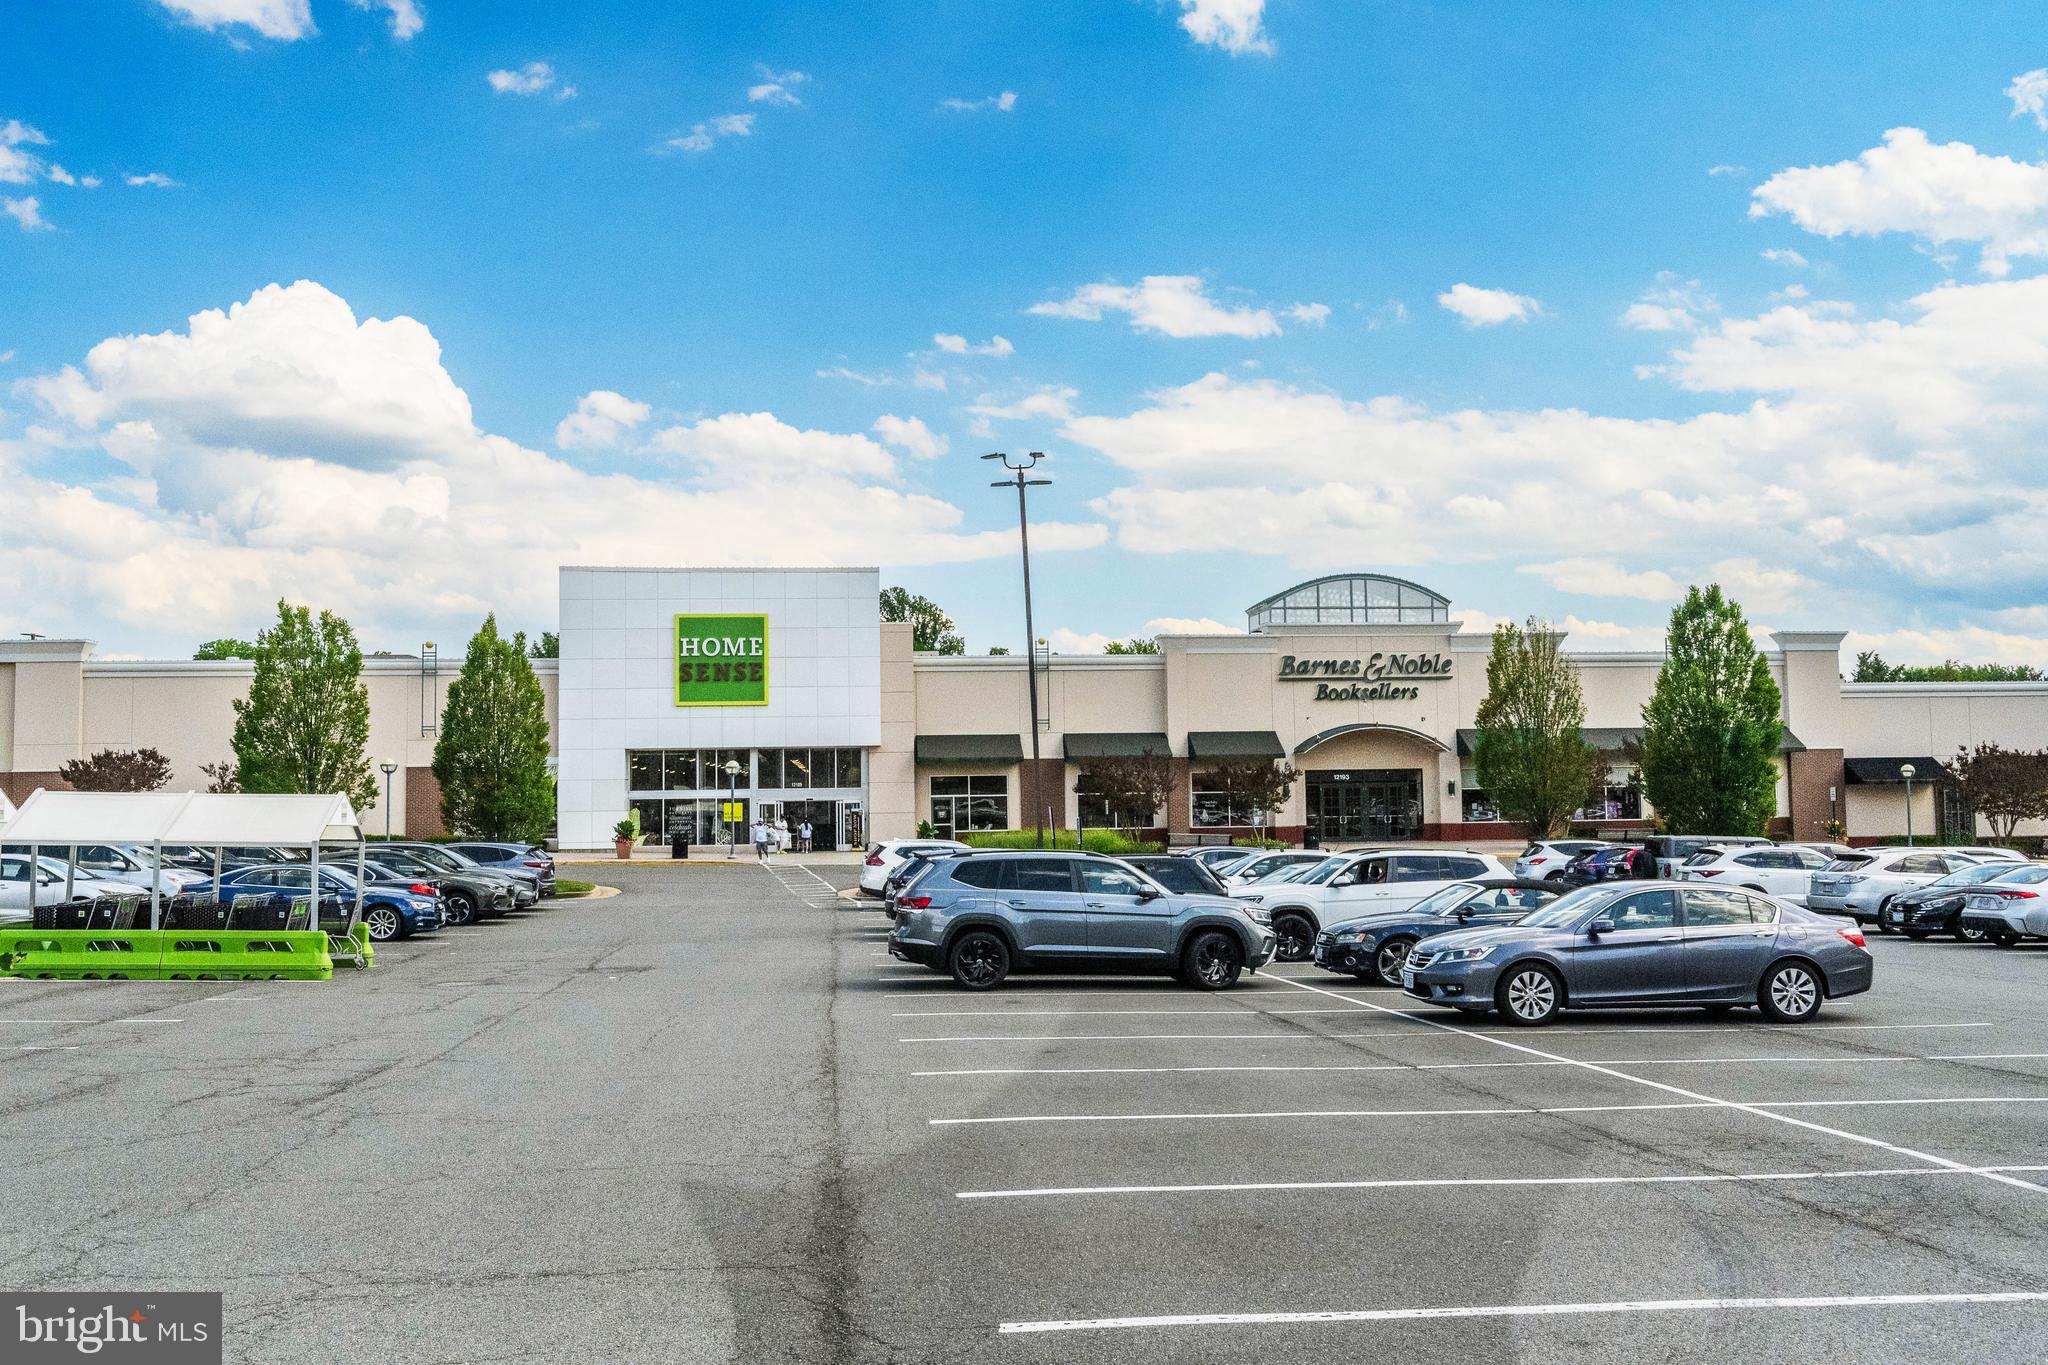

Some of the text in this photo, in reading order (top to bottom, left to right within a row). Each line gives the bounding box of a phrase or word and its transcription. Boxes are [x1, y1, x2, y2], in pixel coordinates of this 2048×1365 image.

[680, 637, 763, 657] HOME
[679, 662, 763, 682] SENSE
[1279, 652, 1453, 682] Barnes & Noble
[1314, 682, 1419, 702] Booksellers
